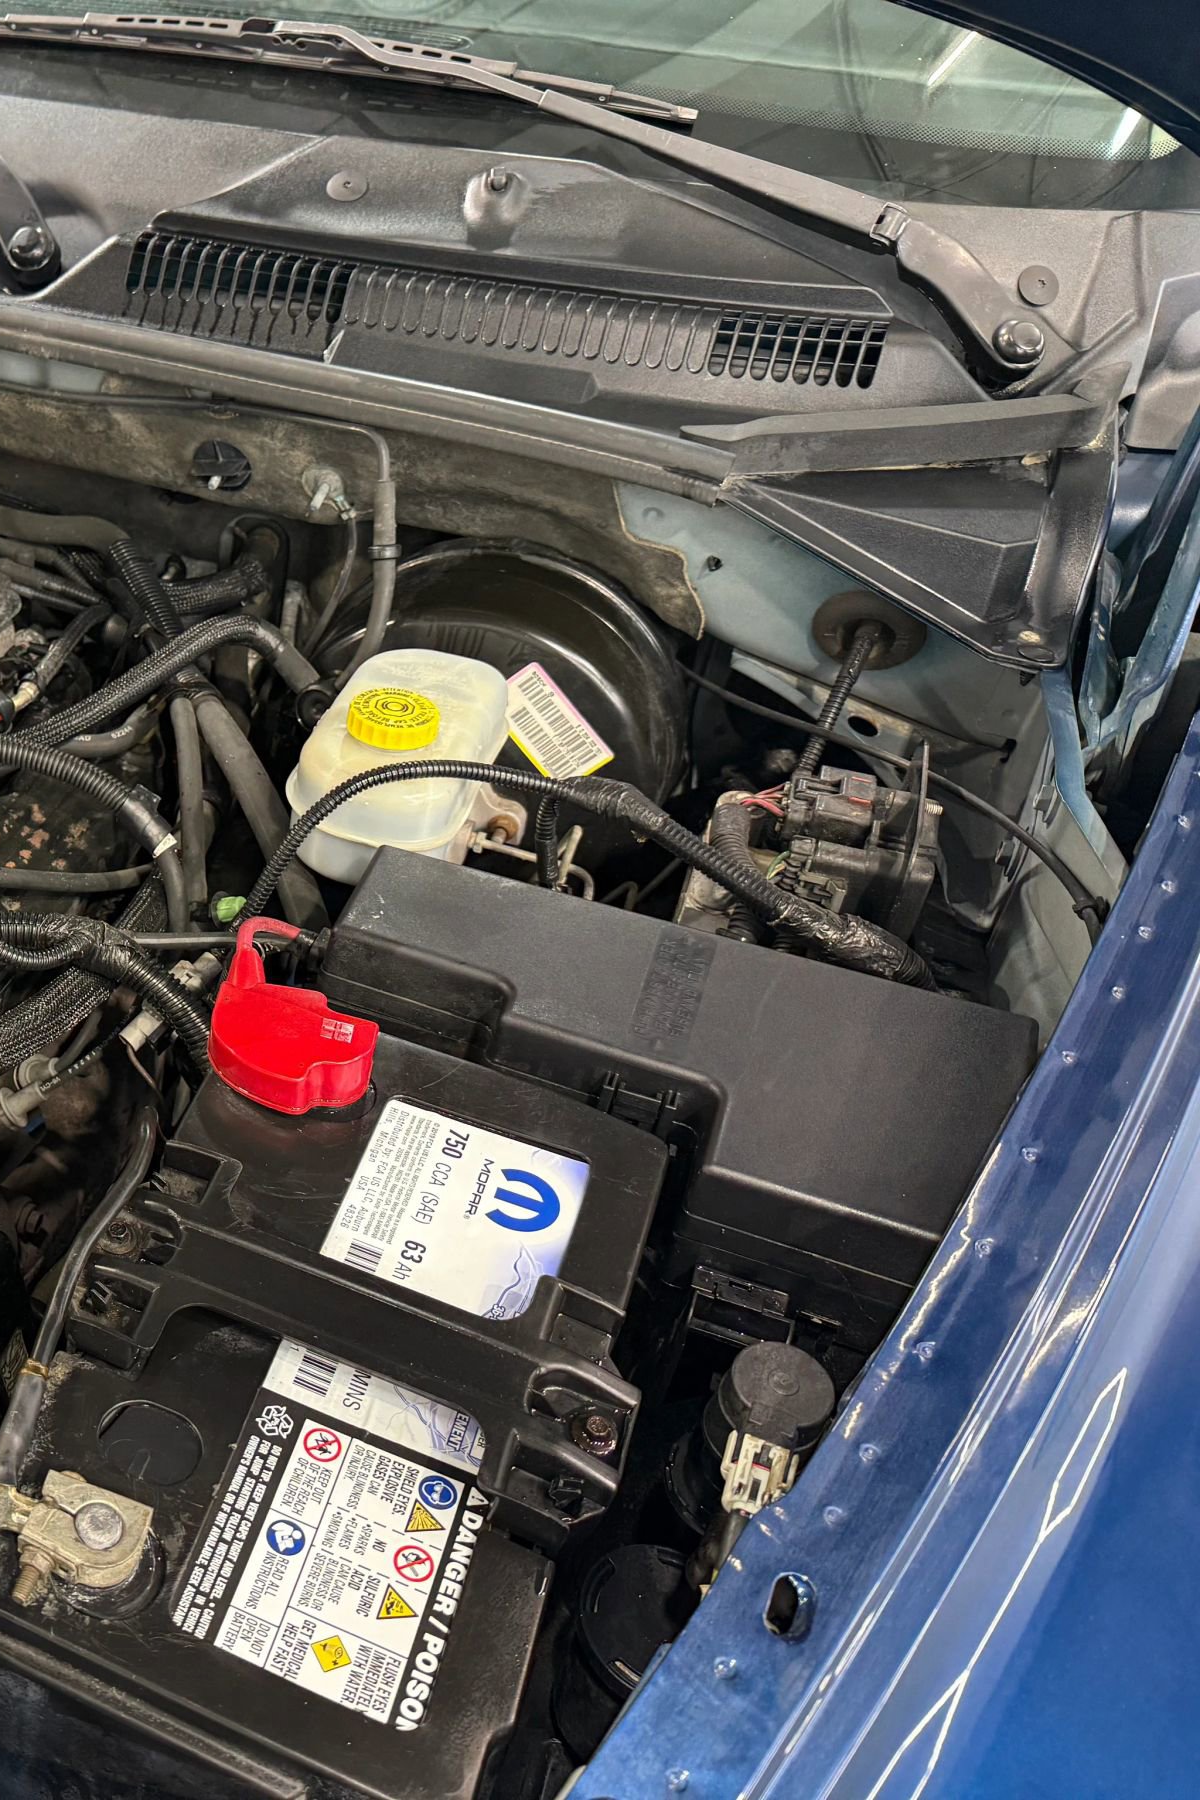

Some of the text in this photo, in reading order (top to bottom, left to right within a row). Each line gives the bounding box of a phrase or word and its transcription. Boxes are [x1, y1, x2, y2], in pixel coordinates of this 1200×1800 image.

[366, 1130, 389, 1163] Michigan
[386, 1110, 410, 1147] Distributed
[355, 1175, 369, 1191] USA
[370, 1176, 381, 1187] US
[375, 1160, 388, 1175] FCA
[409, 1128, 470, 1225] 750 CCA (SAE)
[360, 1187, 376, 1205] LLC,
[339, 1203, 357, 1228] 48326
[350, 1206, 368, 1233] Auburn
[398, 1238, 427, 1264] 63
[390, 1261, 412, 1281] Ah
[264, 1454, 277, 1470] NOT
[270, 1444, 282, 1456] DO
[342, 1443, 364, 1482] OR INJURY.
[250, 1482, 266, 1502] KEEP
[258, 1468, 272, 1484] TIP.
[279, 1456, 309, 1509] OF CHILDREN.
[291, 1461, 320, 1516] OF THE REACH
[310, 1466, 332, 1504] KEEP OUT
[345, 1448, 376, 1509] CAUSE BLINDNESS
[366, 1454, 390, 1496] GASES CAN
[379, 1460, 405, 1503] EXPLOSIVE
[390, 1465, 419, 1518] SHIELD EYES.
[187, 1434, 260, 1586] OWNER'S MANUAL OR IF NOT AVAILABLE, SEEK
[194, 1439, 271, 1605] FOR JUMP STARTING FOLLOW INSTRUCTIONS IN
[243, 1500, 259, 1520] VENT
[235, 1518, 251, 1540] CAPS
[372, 1538, 386, 1553] NO
[226, 1538, 243, 1561] TIGHT
[432, 1509, 482, 1617] DANGER
[219, 1560, 234, 1577] AND
[243, 1550, 276, 1612] INSTRUCTIONS.
[264, 1556, 289, 1599] READ ALL
[296, 1551, 325, 1609] SEVERE BURNS.
[310, 1557, 338, 1611] BLINDNESS OR
[327, 1562, 351, 1605] CAN CAUSE
[347, 1568, 364, 1591] ACID
[209, 1576, 227, 1602] LEVEL.
[355, 1574, 380, 1617] SULFURIC
[220, 1610, 245, 1652] BATTERY.
[239, 1617, 257, 1642] OPEN
[247, 1622, 270, 1657] DO NOT
[270, 1622, 299, 1672] HELP FAST
[282, 1618, 316, 1682] GET MEDICAL
[339, 1642, 372, 1707] WITH WATER.
[371, 1655, 401, 1714] FLUSH EYES
